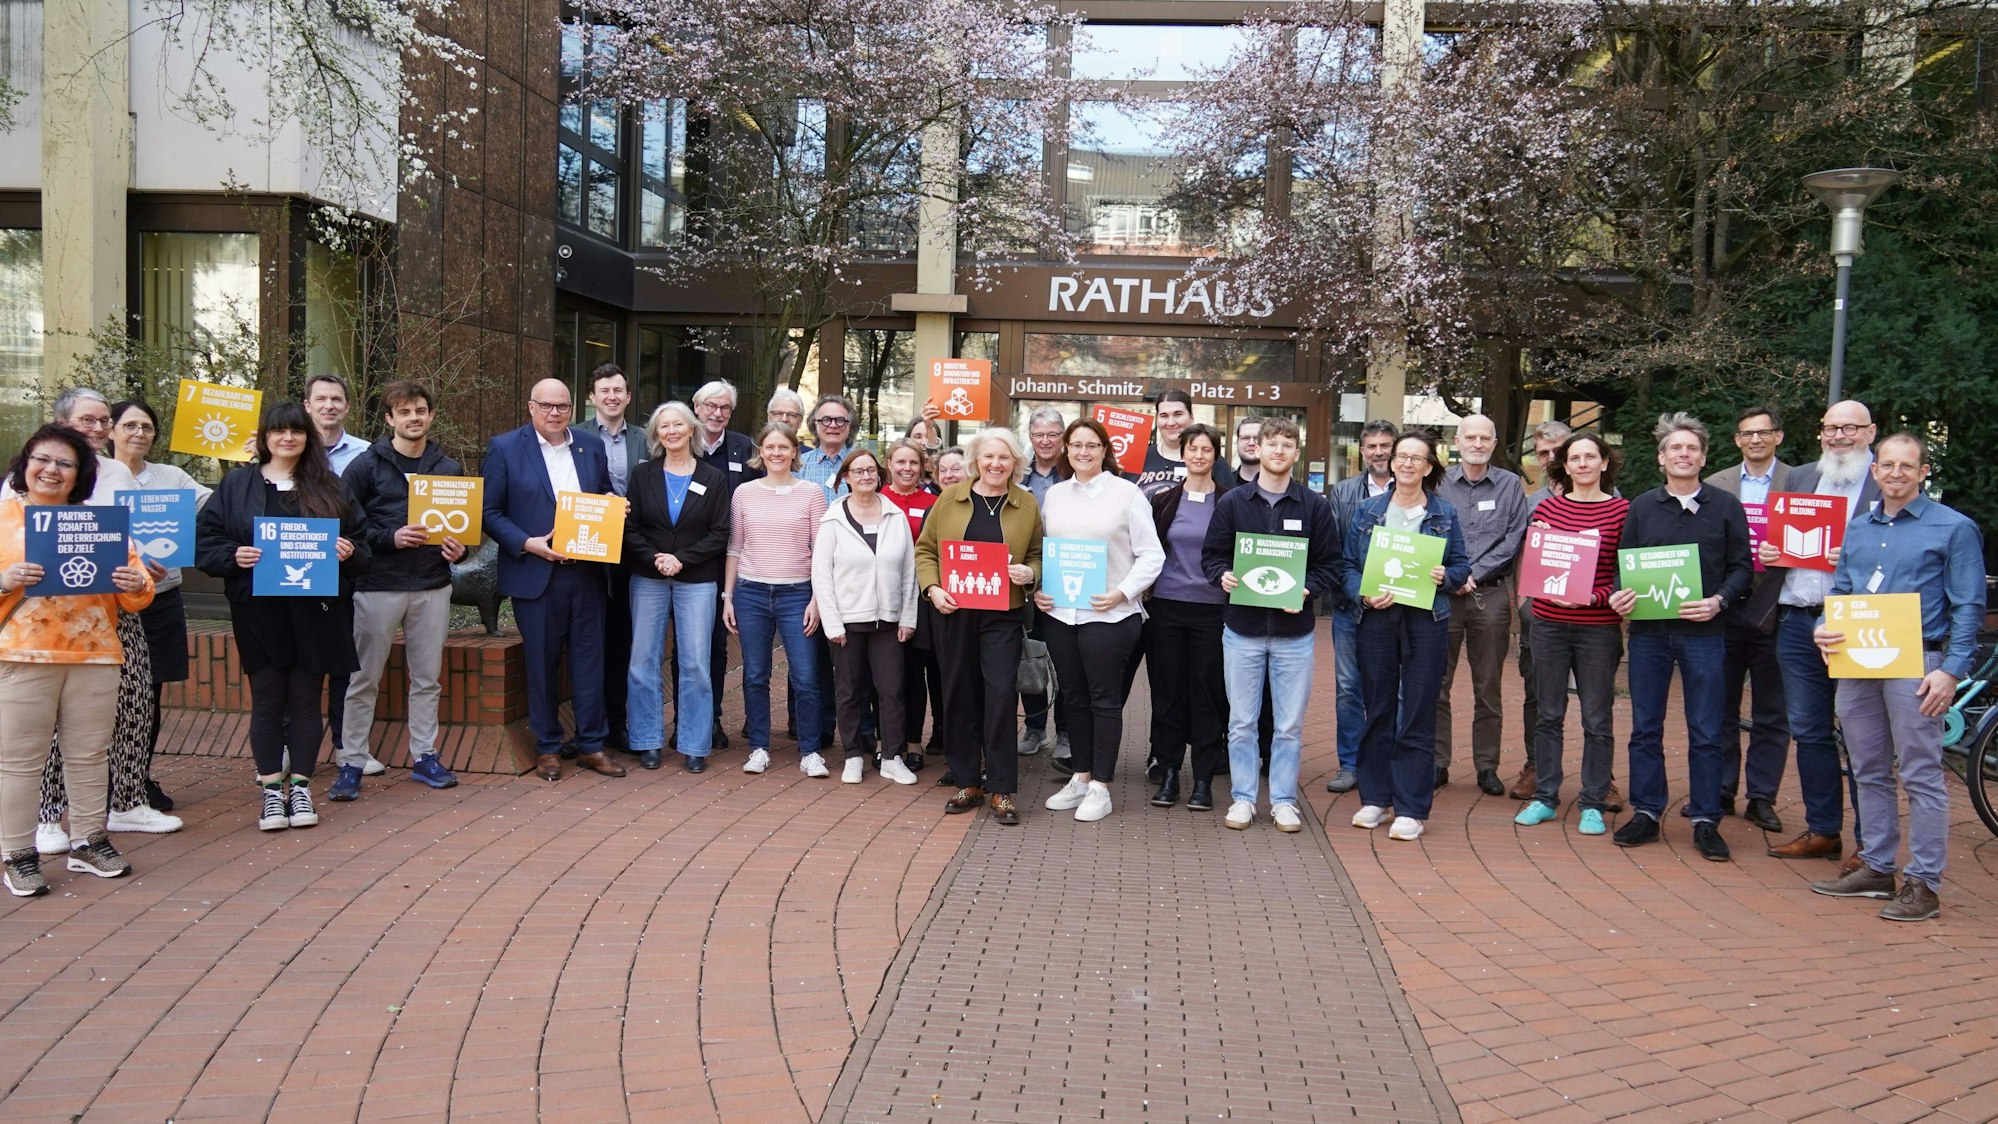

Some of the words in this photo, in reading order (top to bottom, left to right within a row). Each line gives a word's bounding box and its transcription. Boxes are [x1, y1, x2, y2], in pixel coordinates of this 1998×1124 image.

[1048, 276, 1276, 318] RATHAUS
[934, 362, 941, 376] 9
[187, 385, 196, 401] 7
[1009, 377, 1074, 396] Johann-
[1078, 379, 1144, 396] Schmitz
[1190, 382, 1234, 398] Platz
[1245, 384, 1252, 399] 1
[1270, 385, 1280, 400] 3
[202, 388, 242, 400] BEZAHLBARE
[242, 393, 254, 402] UND
[201, 396, 230, 408] SAUBERE
[230, 402, 254, 411] ENERGIE
[1097, 409, 1105, 423] 5
[1110, 411, 1145, 424] GESCHLECHTER-
[1108, 419, 1134, 429] GLEICHHEIT
[414, 480, 428, 495] 12
[432, 480, 475, 489] NACHHALTIGE/R
[160, 494, 180, 502] UNTER
[561, 496, 572, 511] 11
[1790, 497, 1833, 508] HOCHWERTIGE
[119, 496, 135, 513] 14
[141, 504, 166, 512] WASSER
[1774, 497, 1785, 514] 4
[57, 511, 96, 520] PARTNER-
[574, 512, 603, 522] GEMEINDEN
[1790, 507, 1816, 516] BILDUNG
[33, 512, 52, 532] 17
[57, 522, 98, 531] SCHAFTEN
[280, 523, 308, 531] FRIEDEN,
[260, 522, 277, 540] 16
[58, 534, 74, 542] ZUR
[75, 533, 122, 542] ERREICHUNG
[280, 533, 328, 541] GERECHTIGKEIT
[1376, 531, 1390, 548] 15
[1393, 534, 1410, 544] LEBEN
[1531, 532, 1541, 548] 8
[58, 544, 73, 553] DER
[74, 544, 95, 553] ZIELE
[295, 542, 318, 550] STARKE
[1048, 542, 1056, 558] 6
[1240, 538, 1253, 554] 13
[1257, 539, 1294, 549] MASSNAHMEN
[1294, 542, 1306, 550] ZUM
[1400, 544, 1415, 553] LAND
[1543, 542, 1562, 550] ARBEIT
[1562, 544, 1574, 552] UND
[280, 551, 326, 559] INSTITUTIONEN
[948, 545, 954, 560] 1
[1256, 548, 1293, 558] KLIMASCHUTZ
[1542, 550, 1581, 561] WIRTSCHAFTS-
[1640, 551, 1675, 560] GESUNDHEIT
[1541, 558, 1571, 569] WACHSTUM
[1625, 554, 1635, 570] 3
[1640, 559, 1684, 569] WOHLERGEHEN
[1850, 600, 1867, 609] KEIN
[1833, 601, 1844, 620] 2
[1850, 610, 1879, 619] HUNGER
